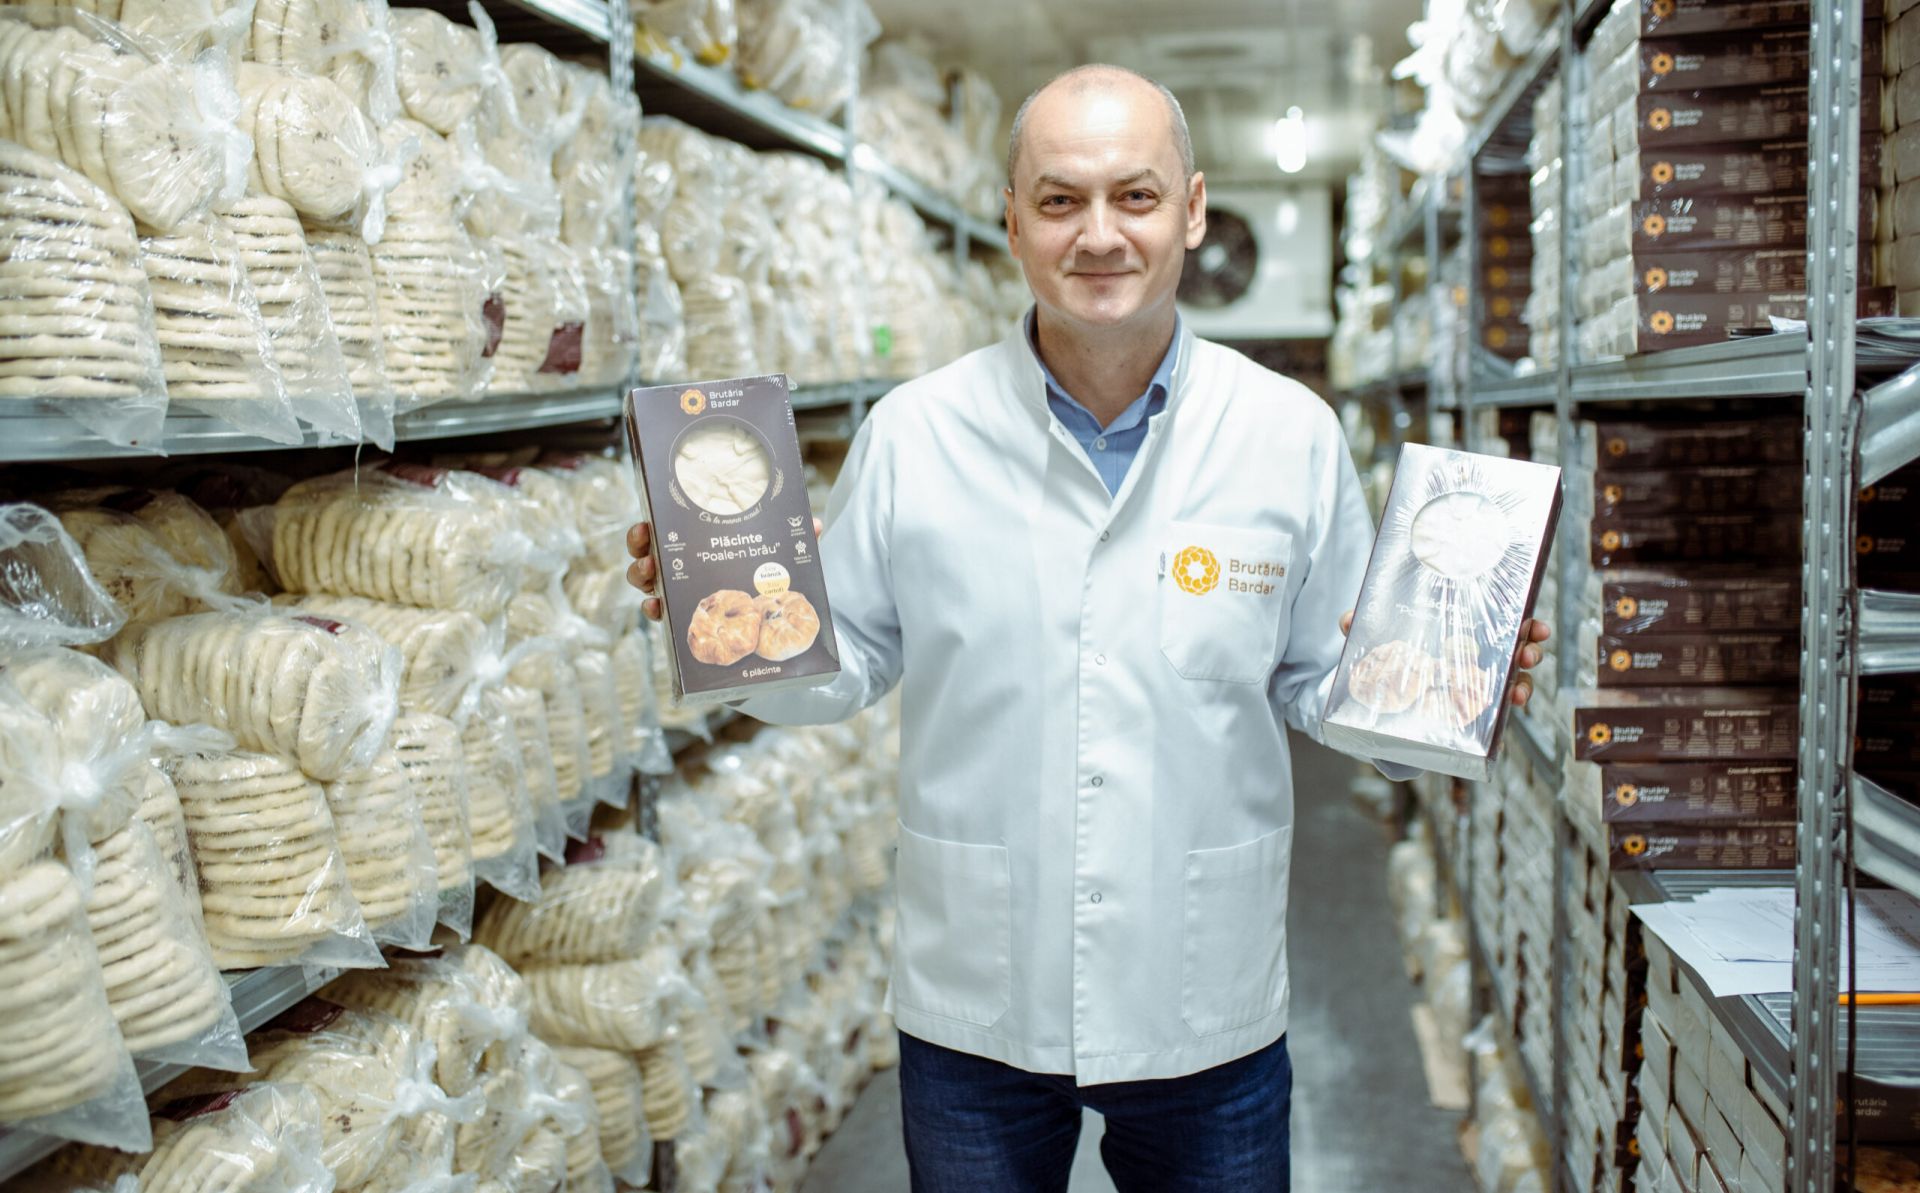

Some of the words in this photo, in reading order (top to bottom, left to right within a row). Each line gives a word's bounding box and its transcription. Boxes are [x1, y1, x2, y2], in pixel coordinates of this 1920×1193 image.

[710, 399, 740, 409] Bardar
[710, 533, 763, 549] Plăcinte
[1229, 578, 1275, 594] Bardar
[742, 669, 749, 678] 6
[750, 665, 782, 679] plăcinte
